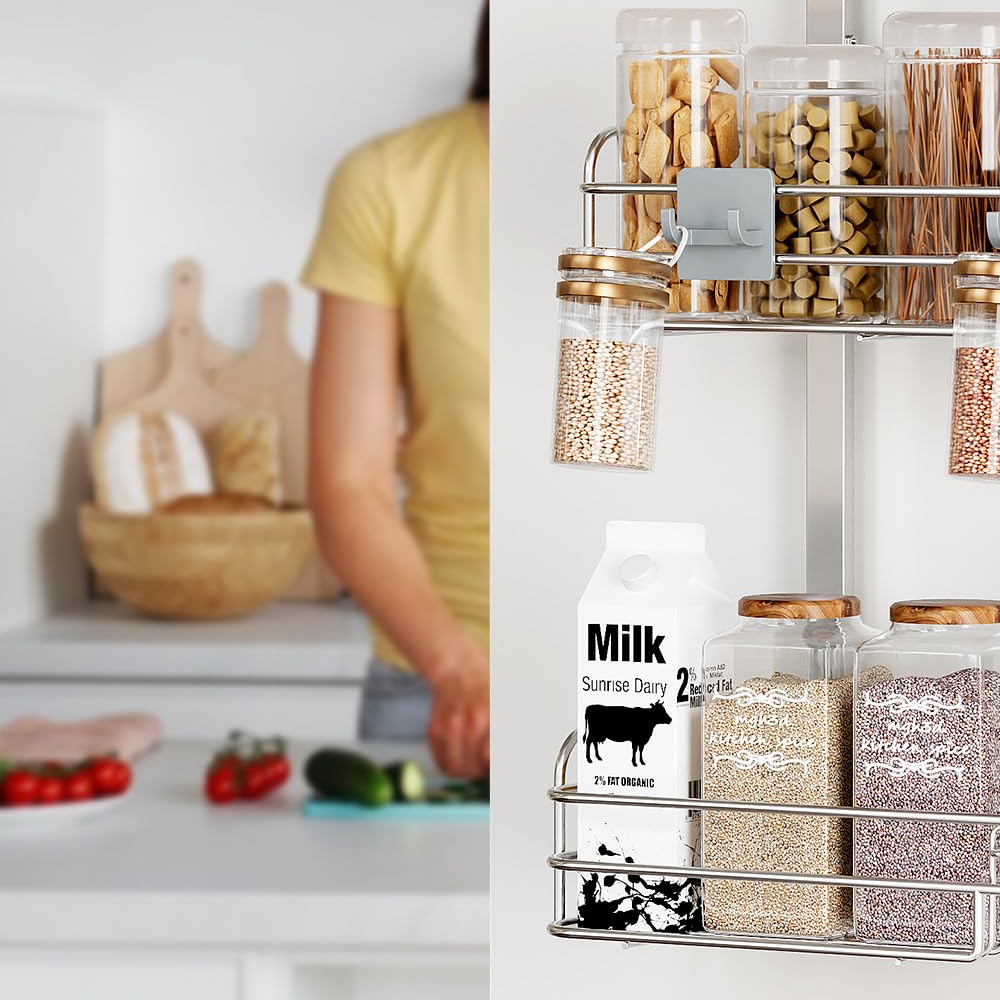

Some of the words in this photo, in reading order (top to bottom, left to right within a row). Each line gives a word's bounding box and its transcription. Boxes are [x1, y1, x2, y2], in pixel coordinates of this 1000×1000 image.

[587, 623, 667, 664] Milk
[582, 676, 630, 693] Sunrise
[634, 677, 668, 698] Dairy
[721, 678, 733, 691] Fat
[594, 775, 606, 786] 2%
[607, 776, 620, 786] FAT
[620, 776, 655, 789] ORGANIC
